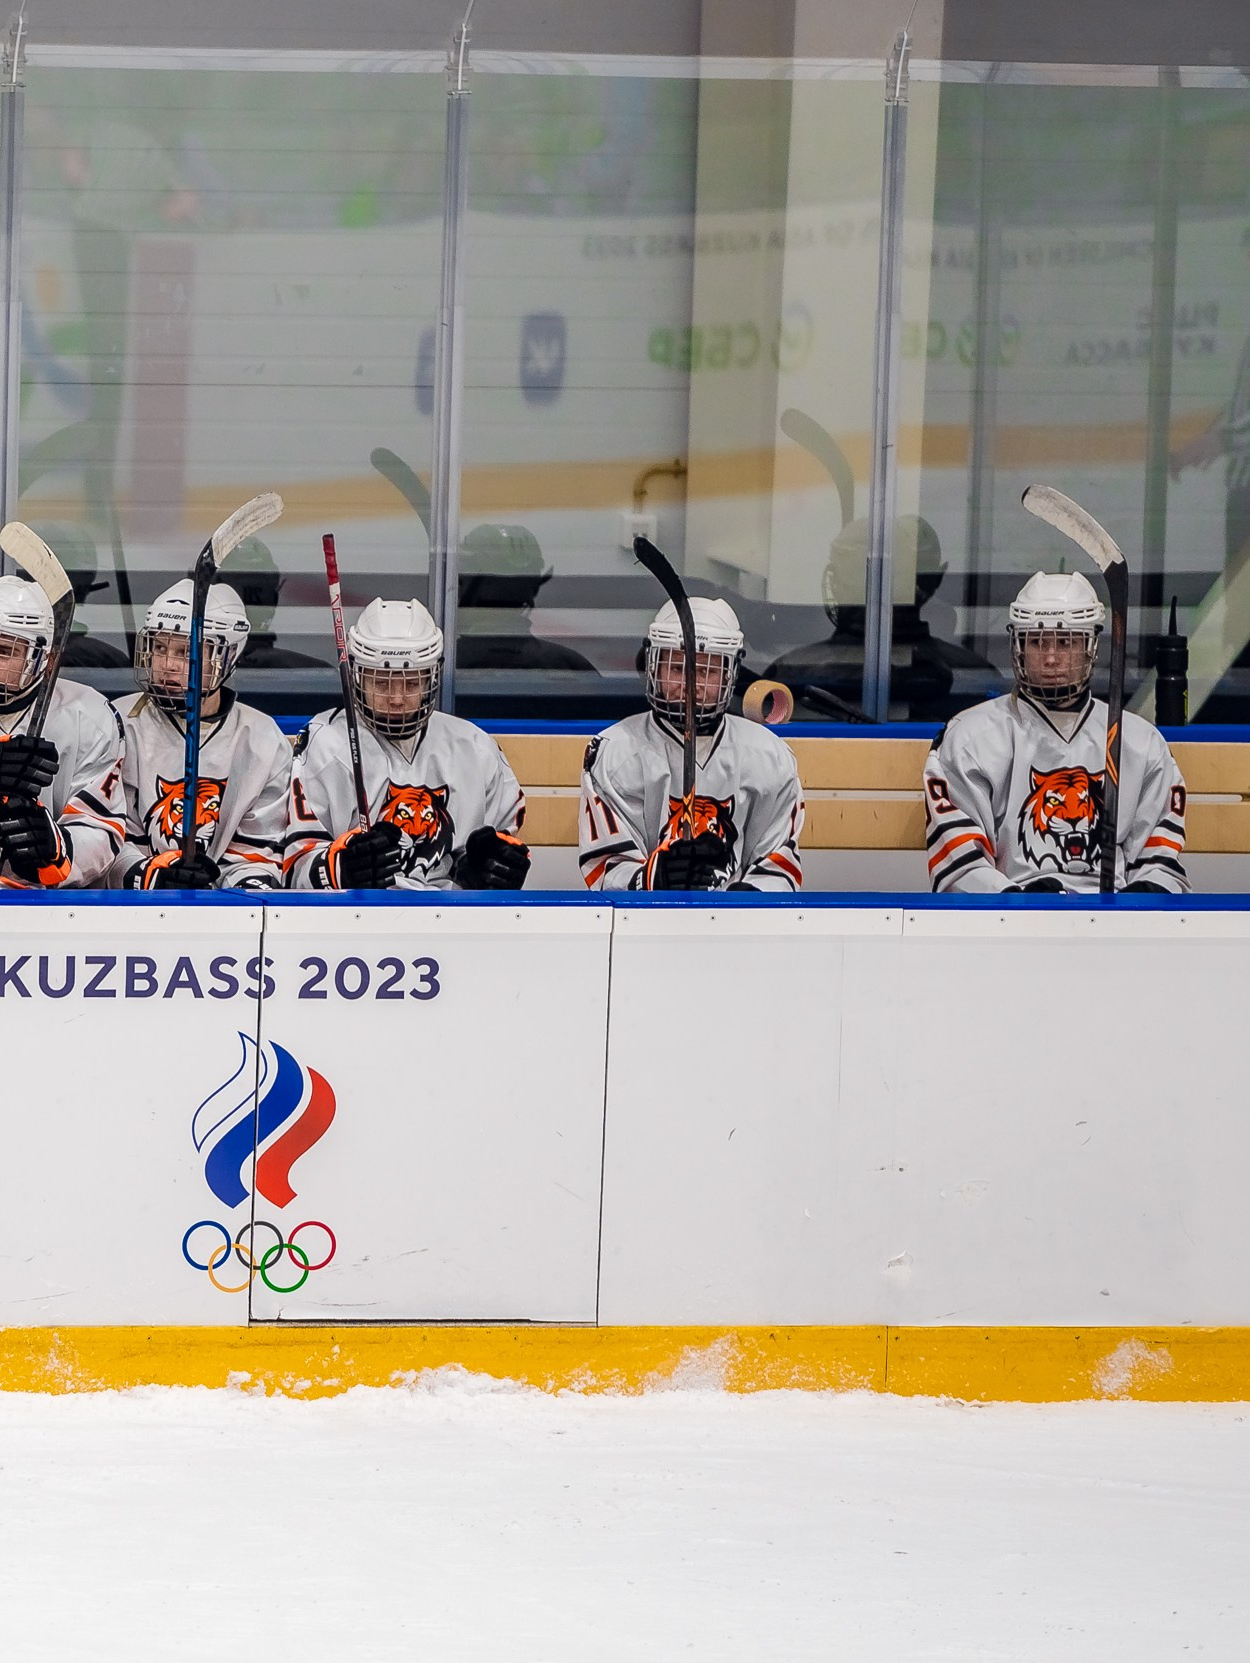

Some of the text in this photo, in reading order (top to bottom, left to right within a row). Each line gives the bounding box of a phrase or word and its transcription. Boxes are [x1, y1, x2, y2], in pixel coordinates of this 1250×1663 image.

[157, 612, 187, 621] BAUER
[585, 795, 620, 842] 11
[924, 777, 959, 832] 9
[298, 956, 440, 1000] 2023
